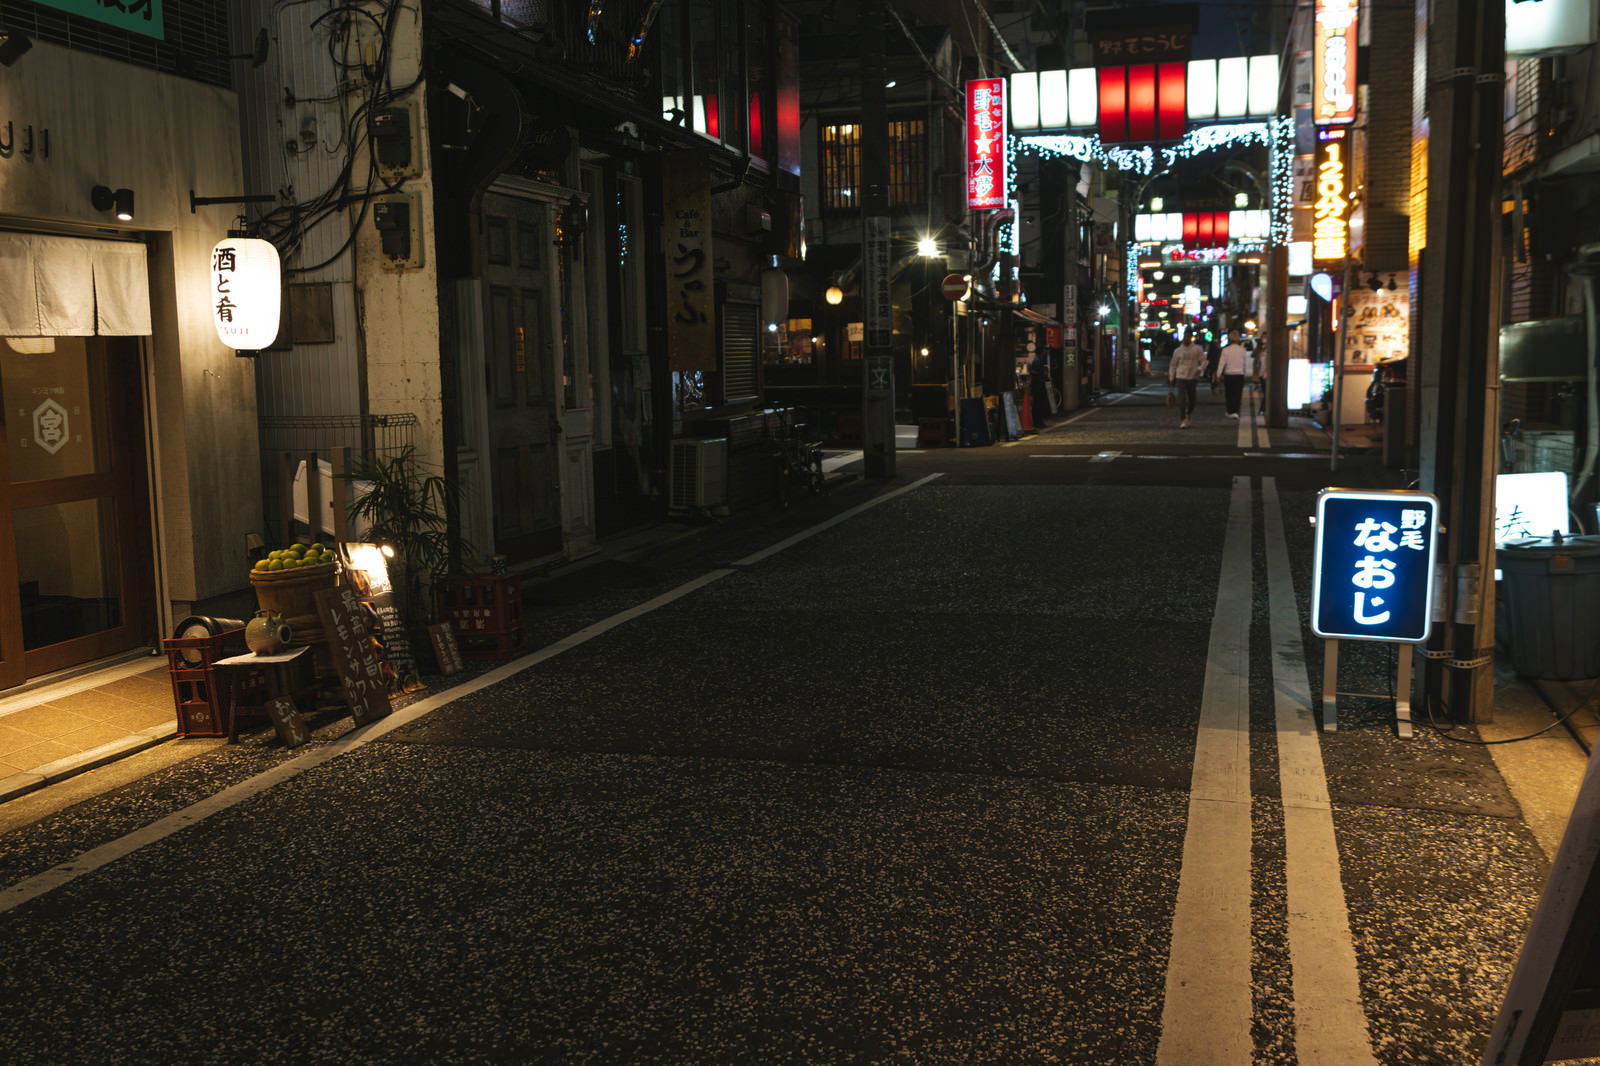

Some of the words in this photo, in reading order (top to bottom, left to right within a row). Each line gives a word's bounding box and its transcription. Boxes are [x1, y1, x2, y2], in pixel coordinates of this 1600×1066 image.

[679, 228, 699, 238] Bar
[213, 247, 238, 323] 酒と肴
[1399, 509, 1427, 551] 野毛
[330, 608, 369, 711] レモンサワー
[274, 700, 304, 742] おでん
